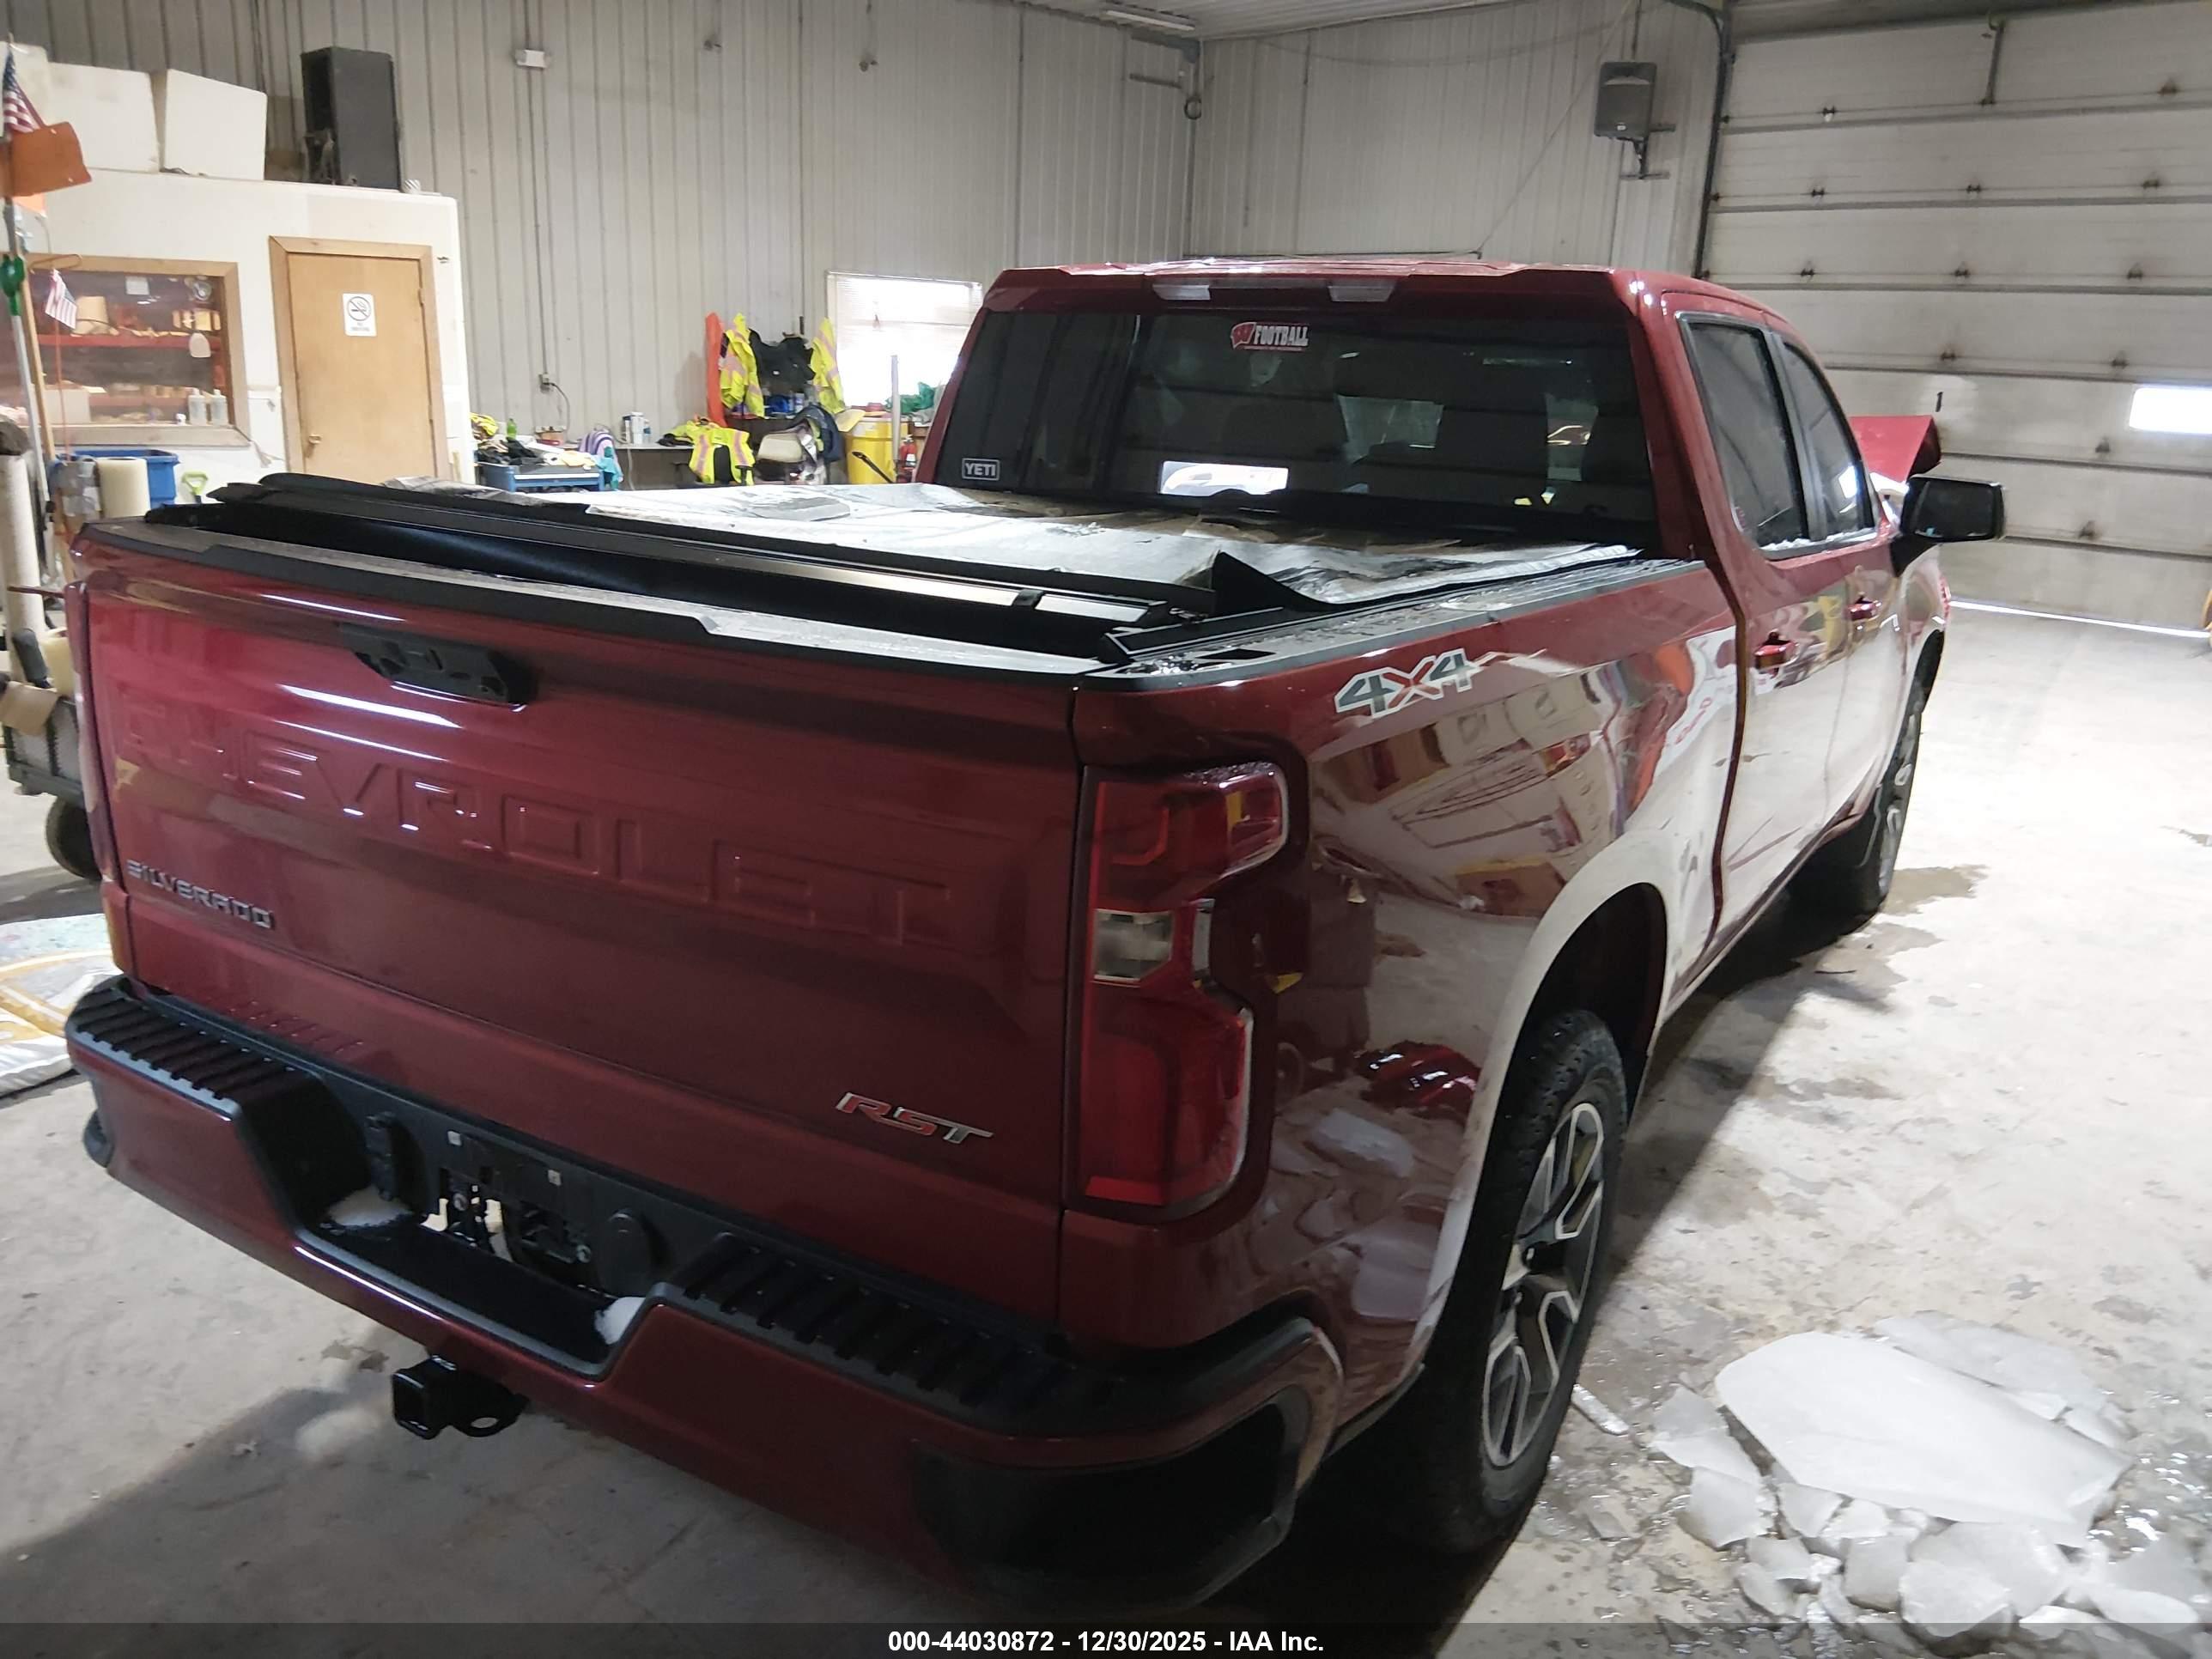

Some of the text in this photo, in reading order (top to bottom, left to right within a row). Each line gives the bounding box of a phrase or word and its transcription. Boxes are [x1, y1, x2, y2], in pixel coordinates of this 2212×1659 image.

[1254, 325, 1309, 347] FOOTBALL
[965, 463, 996, 477] YETI
[126, 859, 275, 930] SILVERADO
[836, 1091, 994, 1144] RST
